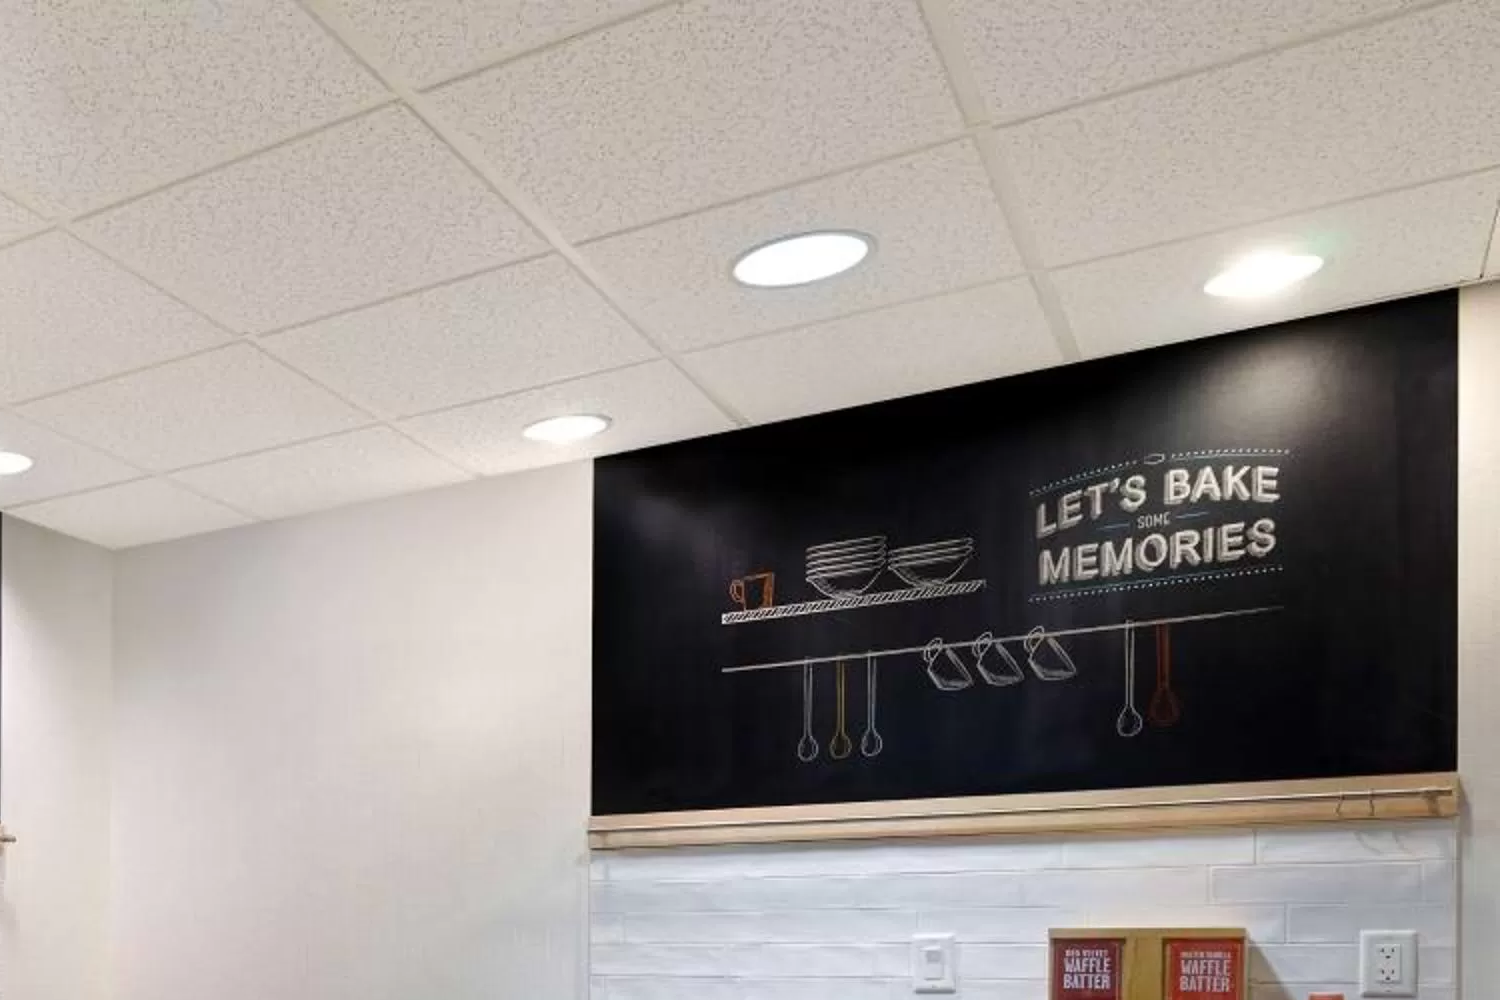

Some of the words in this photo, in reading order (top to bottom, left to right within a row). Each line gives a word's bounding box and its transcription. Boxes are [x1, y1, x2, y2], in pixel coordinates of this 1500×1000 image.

[1036, 474, 1148, 538] LET'S
[1163, 465, 1281, 505] BAKE
[1136, 511, 1172, 530] SOME
[1038, 518, 1277, 586] MEMORIES
[1063, 957, 1113, 973] WAFFLE
[1180, 959, 1232, 975] WAFFLE
[1063, 973, 1111, 990] BATTER
[1179, 975, 1231, 993] BATTER
